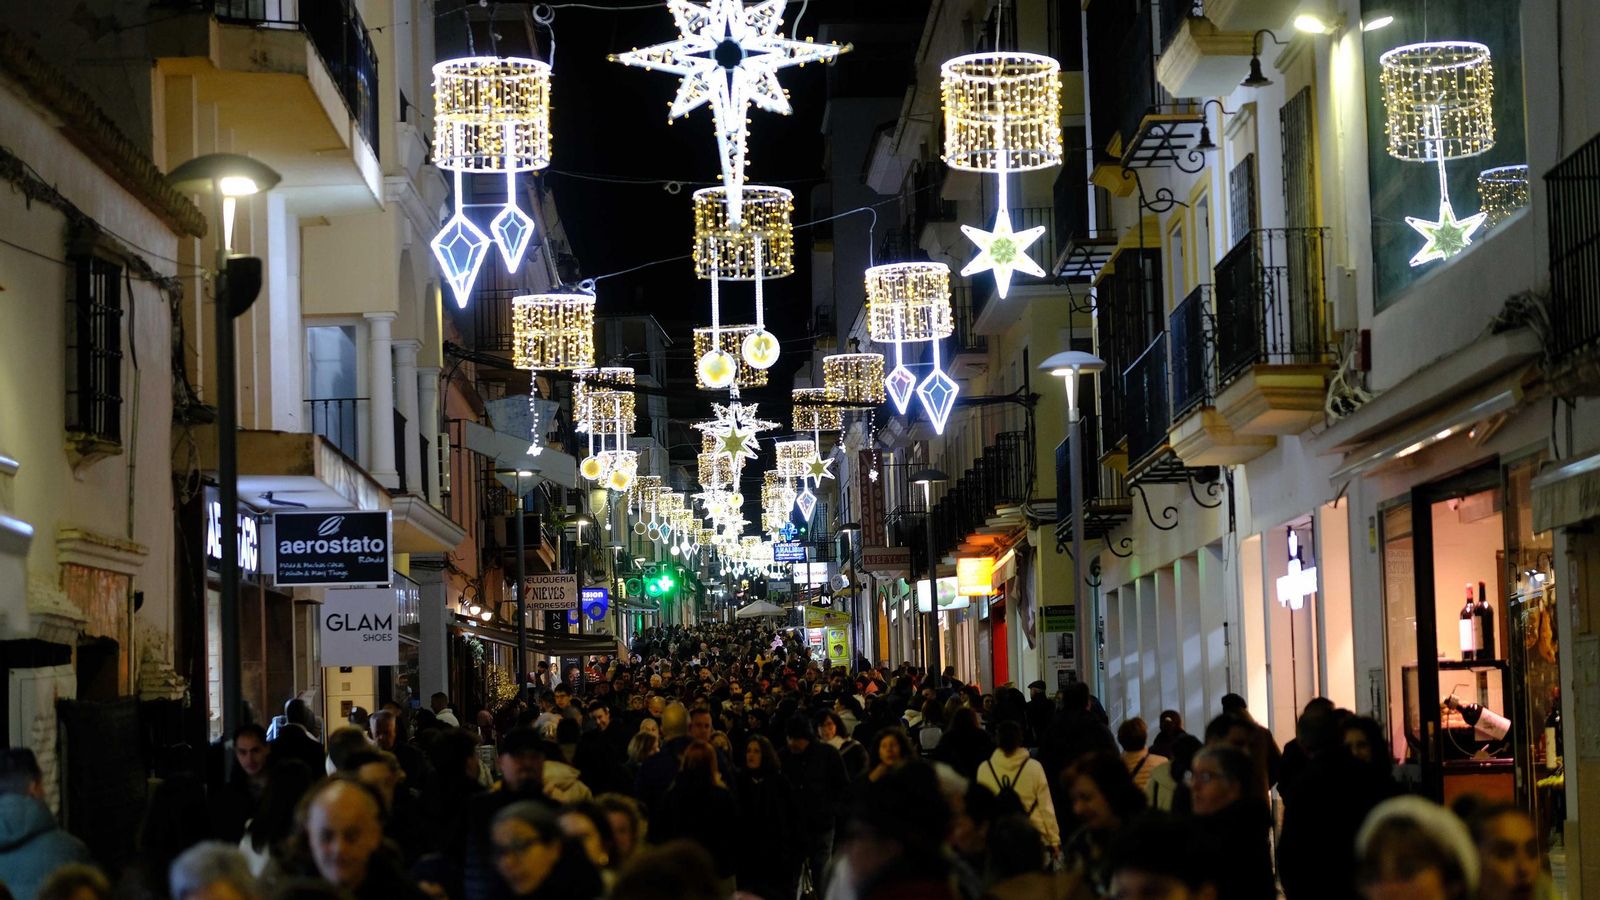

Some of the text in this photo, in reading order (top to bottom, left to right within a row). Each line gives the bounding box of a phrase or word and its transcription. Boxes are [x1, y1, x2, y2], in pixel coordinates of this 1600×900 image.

[280, 536, 385, 554] aerostato
[532, 587, 565, 600] NIEVES
[821, 595, 831, 605] IN
[326, 613, 392, 632] GLAM
[363, 633, 393, 642] SHOES
